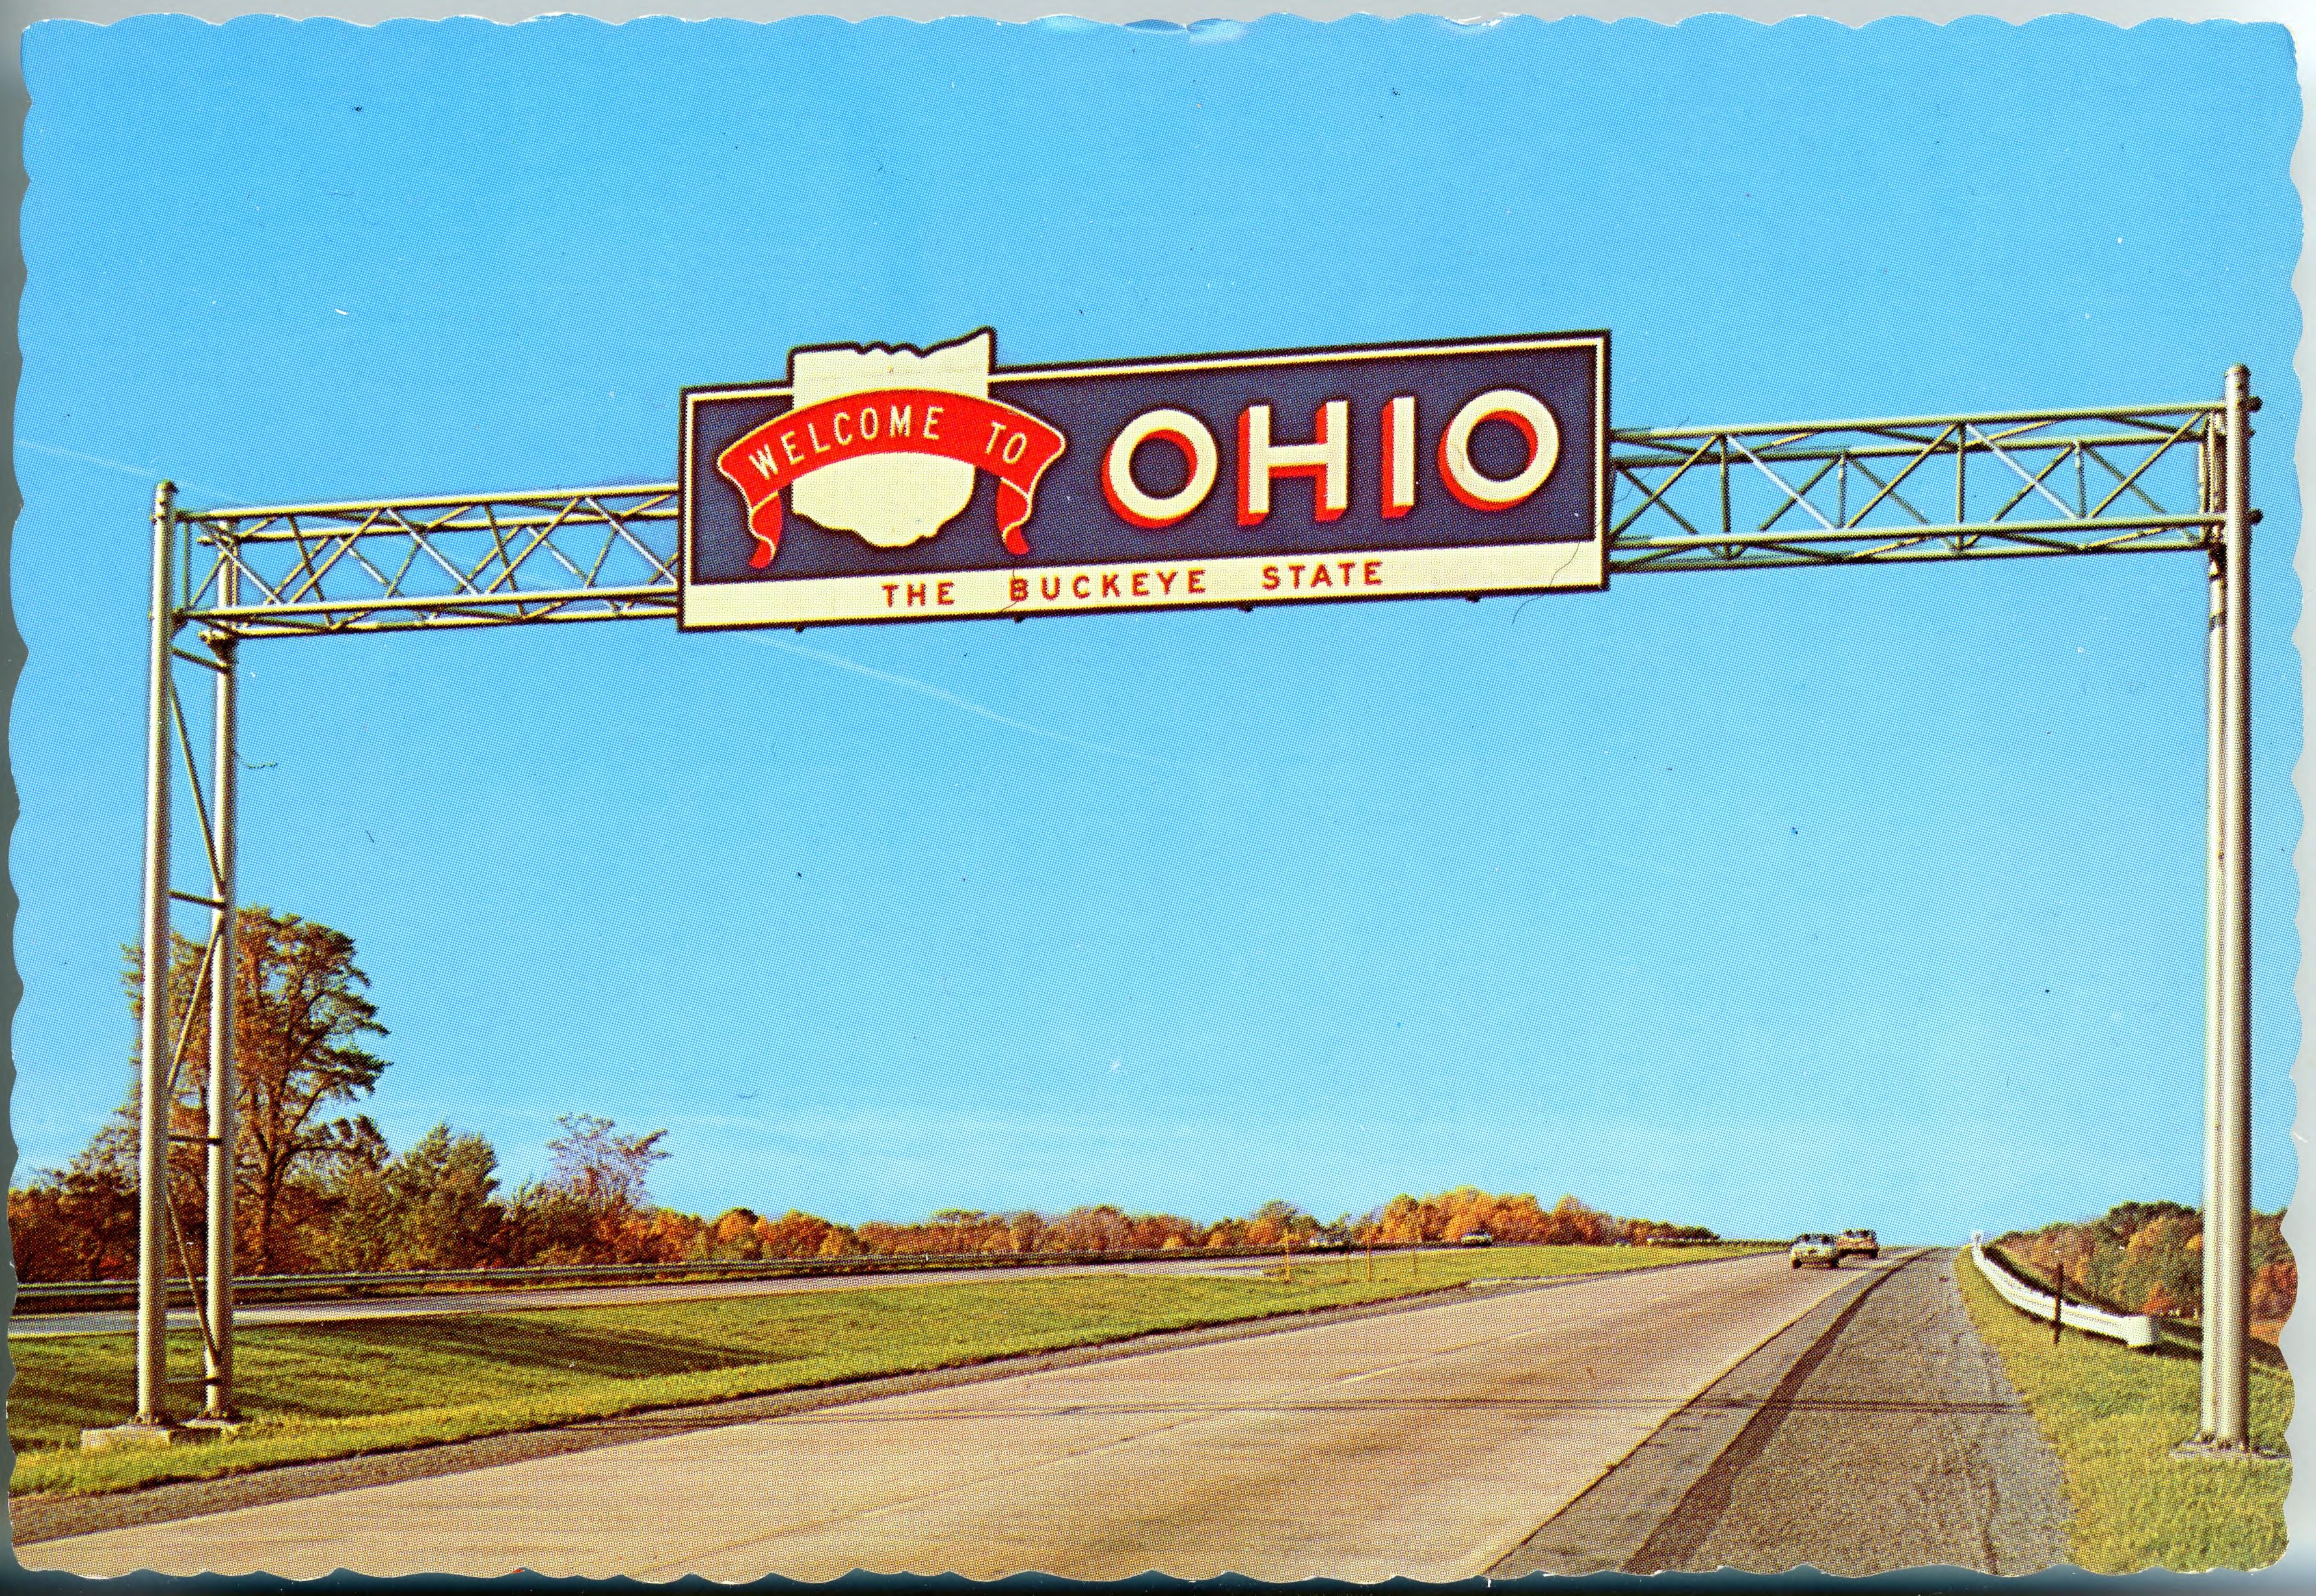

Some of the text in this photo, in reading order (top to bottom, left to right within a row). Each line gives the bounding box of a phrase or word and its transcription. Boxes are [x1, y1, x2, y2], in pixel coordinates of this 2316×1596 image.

[748, 405, 1029, 480] WELCOME TO
[1101, 389, 1559, 528] OHIO
[882, 560, 1384, 608] THE BUCKEYE STATE
